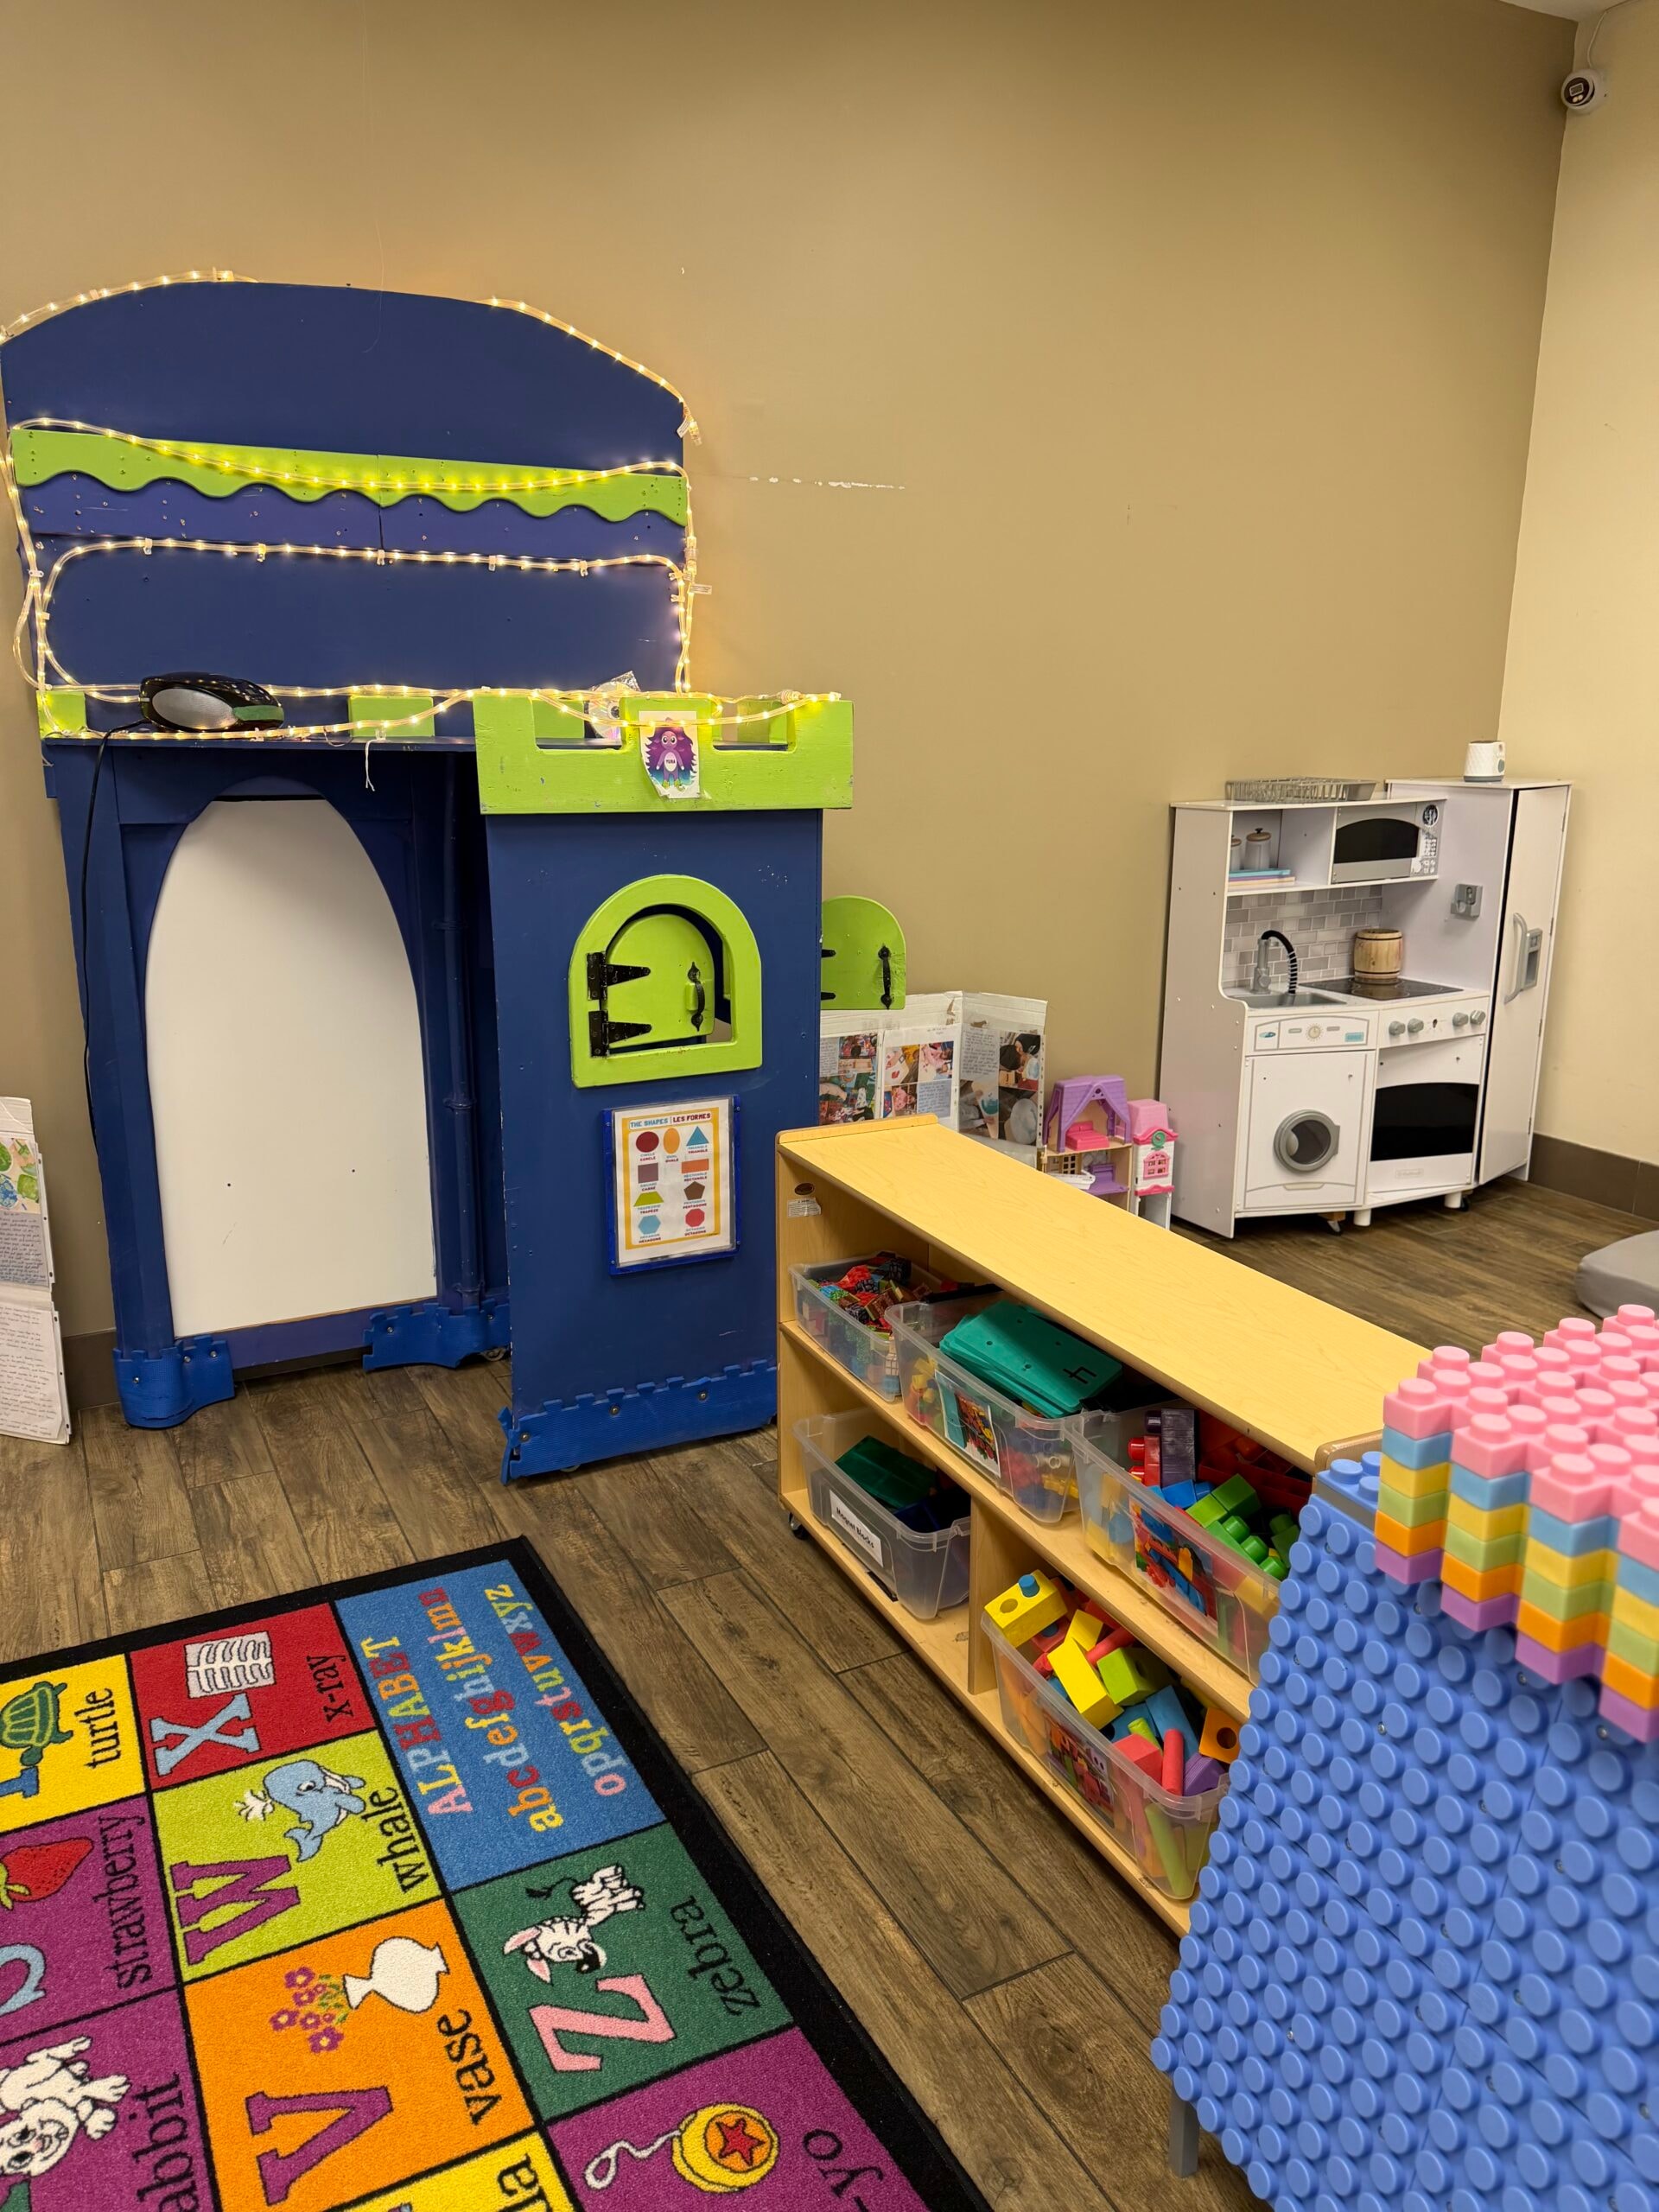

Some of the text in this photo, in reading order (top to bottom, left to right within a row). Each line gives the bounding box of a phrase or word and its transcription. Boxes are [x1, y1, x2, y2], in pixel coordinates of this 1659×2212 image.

[645, 1118, 668, 1127] SHAPES
[687, 1113, 710, 1122] FORMES
[74, 1688, 121, 1769] turtle
[149, 1692, 262, 1777] X
[306, 1655, 354, 1723] x-ray
[359, 1636, 474, 1815] ALPHABET
[417, 1586, 564, 1832] abcdefghijklmn
[484, 1584, 628, 1796] opqrstuvwxyz
[361, 1787, 429, 1894] whale
[93, 1815, 153, 1989] strawberry
[170, 1854, 301, 1966] W
[670, 1895, 760, 2017] zebra
[436, 2008, 503, 2126] vase
[528, 1974, 677, 2072] Z
[245, 2085, 393, 2207] V
